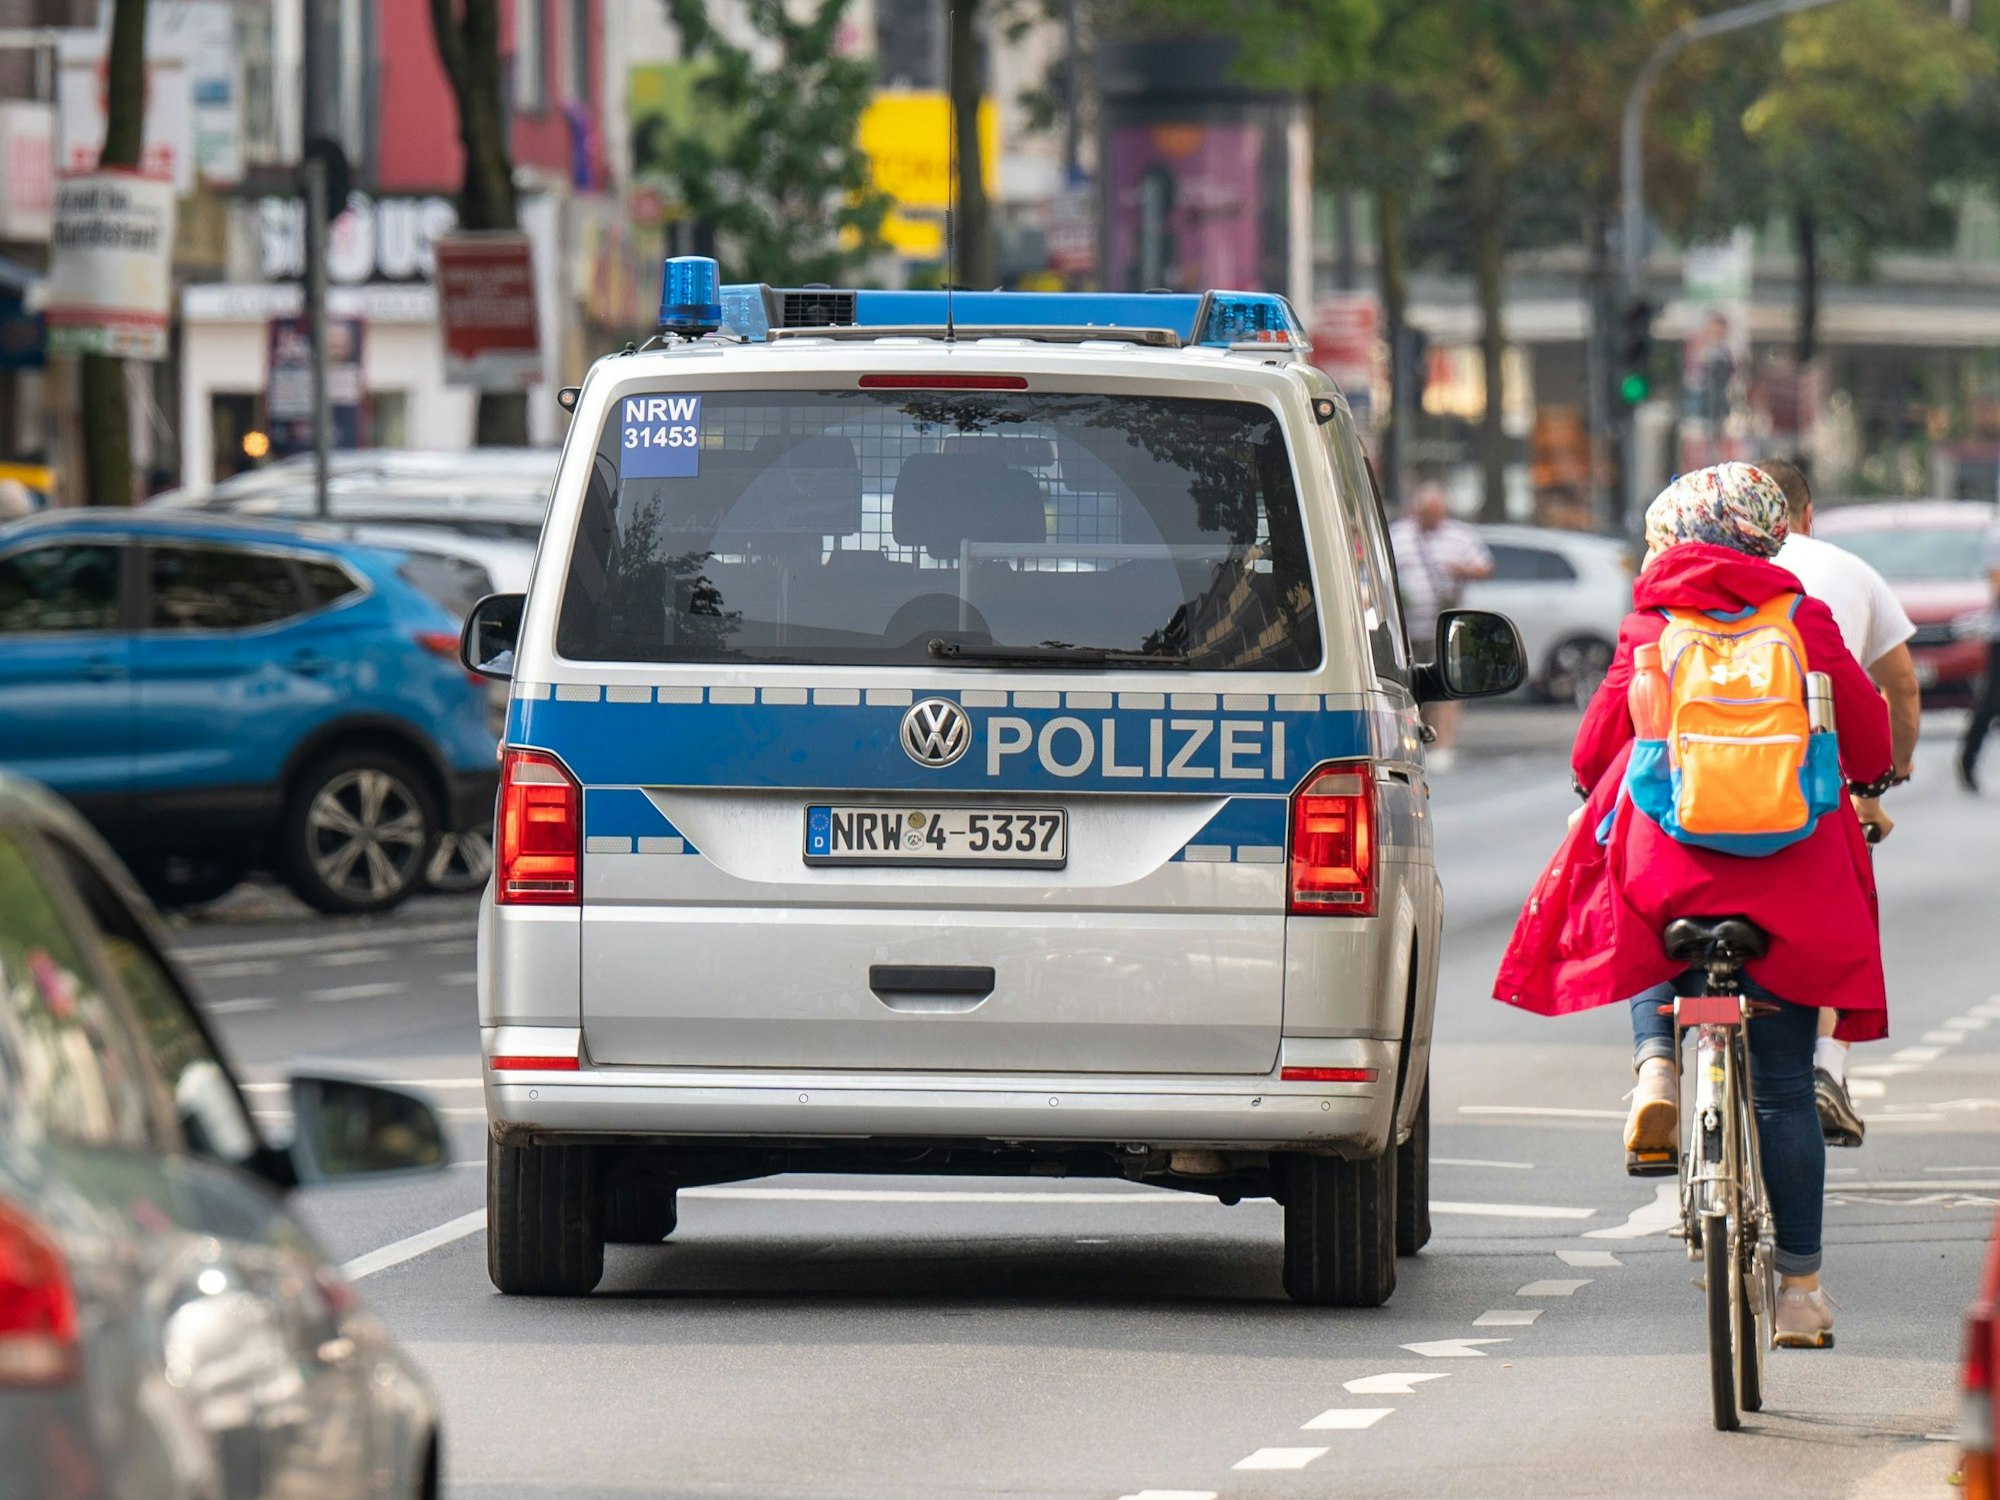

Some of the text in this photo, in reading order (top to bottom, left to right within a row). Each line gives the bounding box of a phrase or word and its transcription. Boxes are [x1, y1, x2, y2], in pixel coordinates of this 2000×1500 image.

[626, 398, 697, 422] NRW
[624, 426, 698, 448] 31453
[903, 699, 969, 766] VW
[986, 716, 1286, 780] POLIZEI
[814, 813, 1061, 852] D NRW 4-5337
